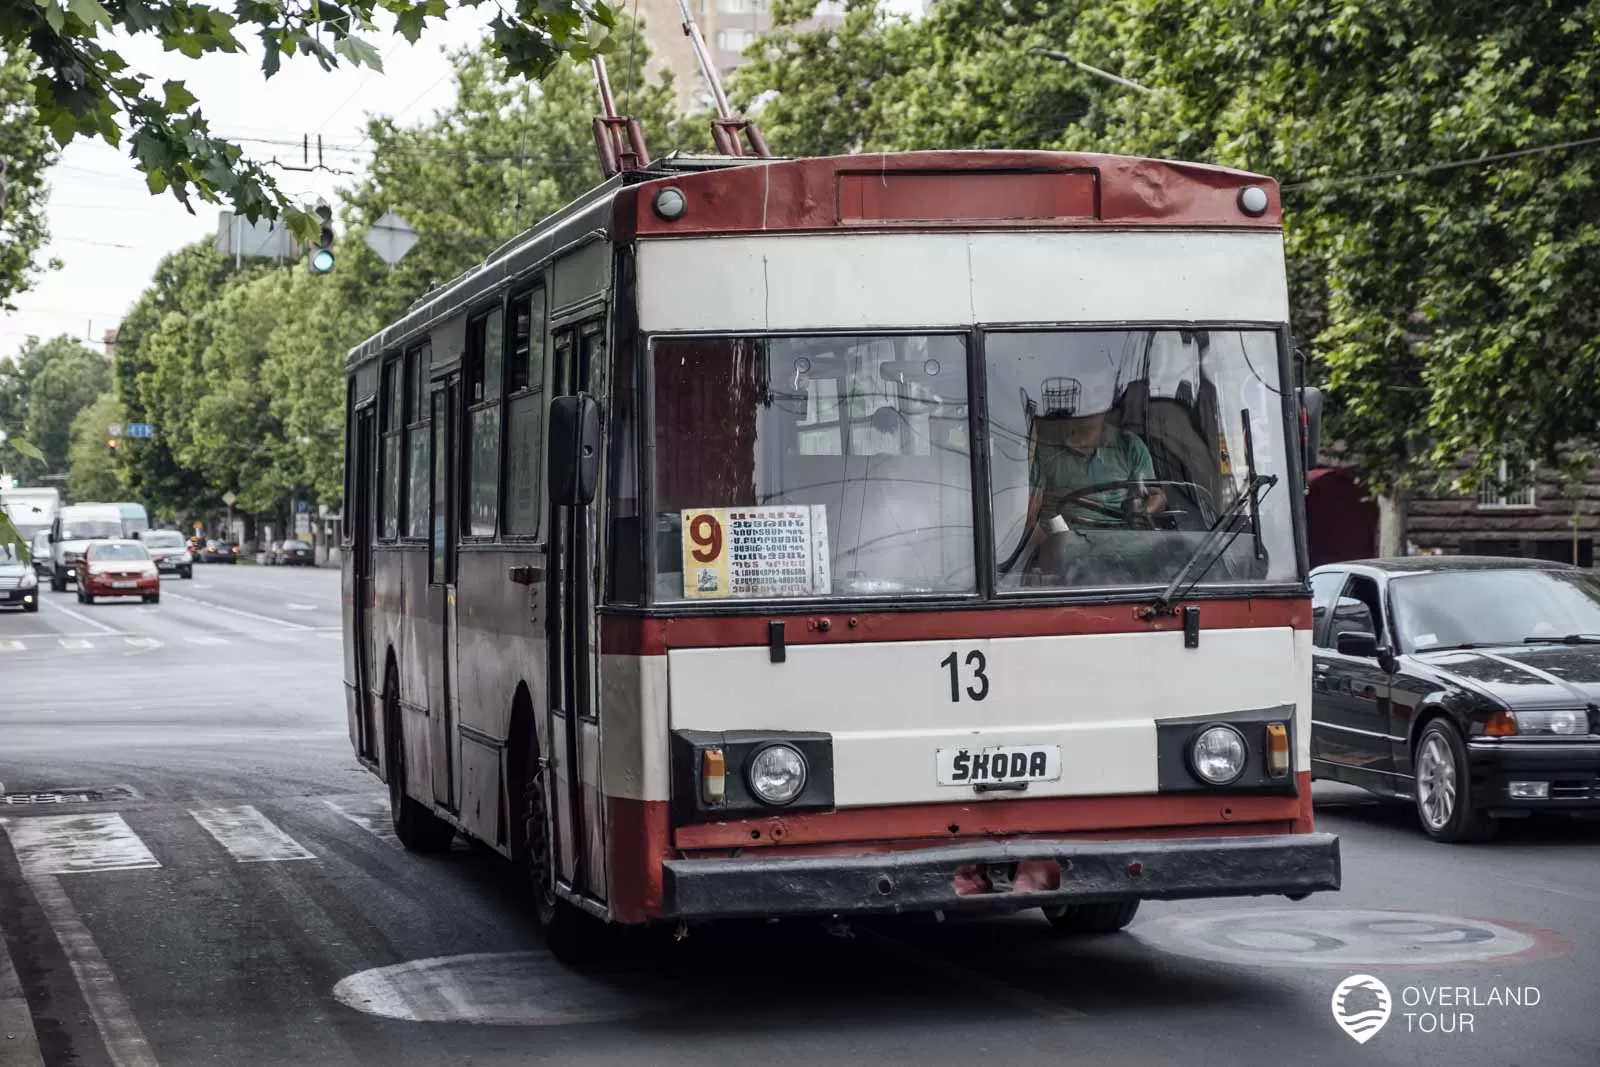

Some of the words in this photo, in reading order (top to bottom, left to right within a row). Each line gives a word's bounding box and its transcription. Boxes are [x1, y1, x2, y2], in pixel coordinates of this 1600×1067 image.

[690, 514, 722, 562] 9
[940, 649, 989, 702] 13
[952, 750, 1047, 780] ŠKODA
